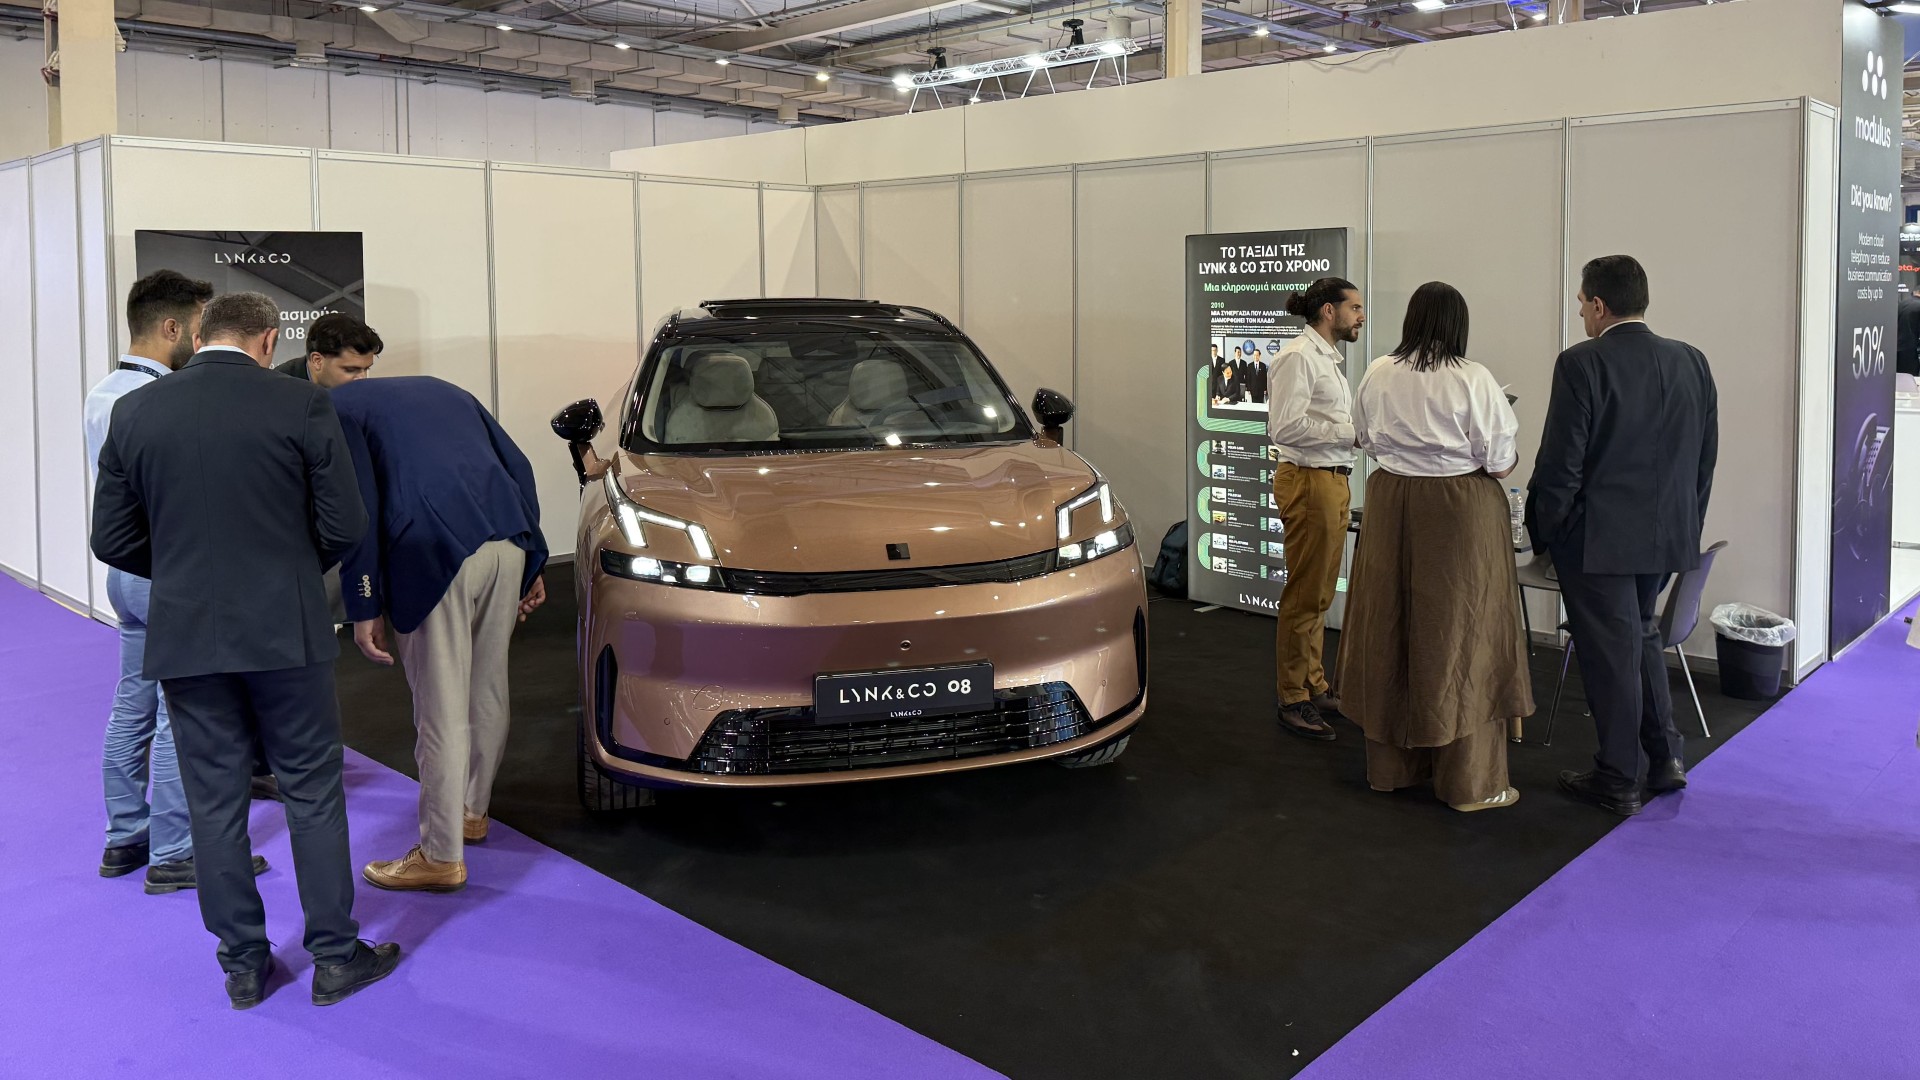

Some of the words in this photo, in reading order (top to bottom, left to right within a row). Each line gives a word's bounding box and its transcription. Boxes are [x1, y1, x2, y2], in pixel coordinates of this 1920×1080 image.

[1855, 115, 1891, 148] modulus
[1850, 184, 1861, 207] Did
[1861, 191, 1873, 213] you
[1873, 189, 1892, 212] know?
[1858, 232, 1873, 246] Modern
[1873, 234, 1885, 247] cloud
[214, 252, 291, 265] LYNK&CO
[1220, 246, 1236, 259] ΤΟ
[1239, 245, 1278, 258] ΤΑΞΙΔΙ
[1281, 243, 1306, 256] ΤΗΣ
[1850, 249, 1870, 266] telephony
[1198, 262, 1227, 275] LYNK
[1229, 262, 1238, 274] &
[1240, 262, 1257, 274] CO
[1259, 261, 1283, 273] ΣΤΟ
[1285, 259, 1331, 272] ΧΡΟΝΟ
[1847, 267, 1865, 281] business
[1864, 269, 1892, 282] communication
[1204, 283, 1220, 292] Μια
[1221, 281, 1269, 294] κληρονομιά
[285, 327, 305, 340] 08
[1852, 324, 1885, 380] 50%
[1239, 593, 1280, 610] LYNK&C
[839, 682, 937, 704] LYNK&CO
[947, 678, 971, 695] 08
[890, 709, 922, 718] LYNK&CO
